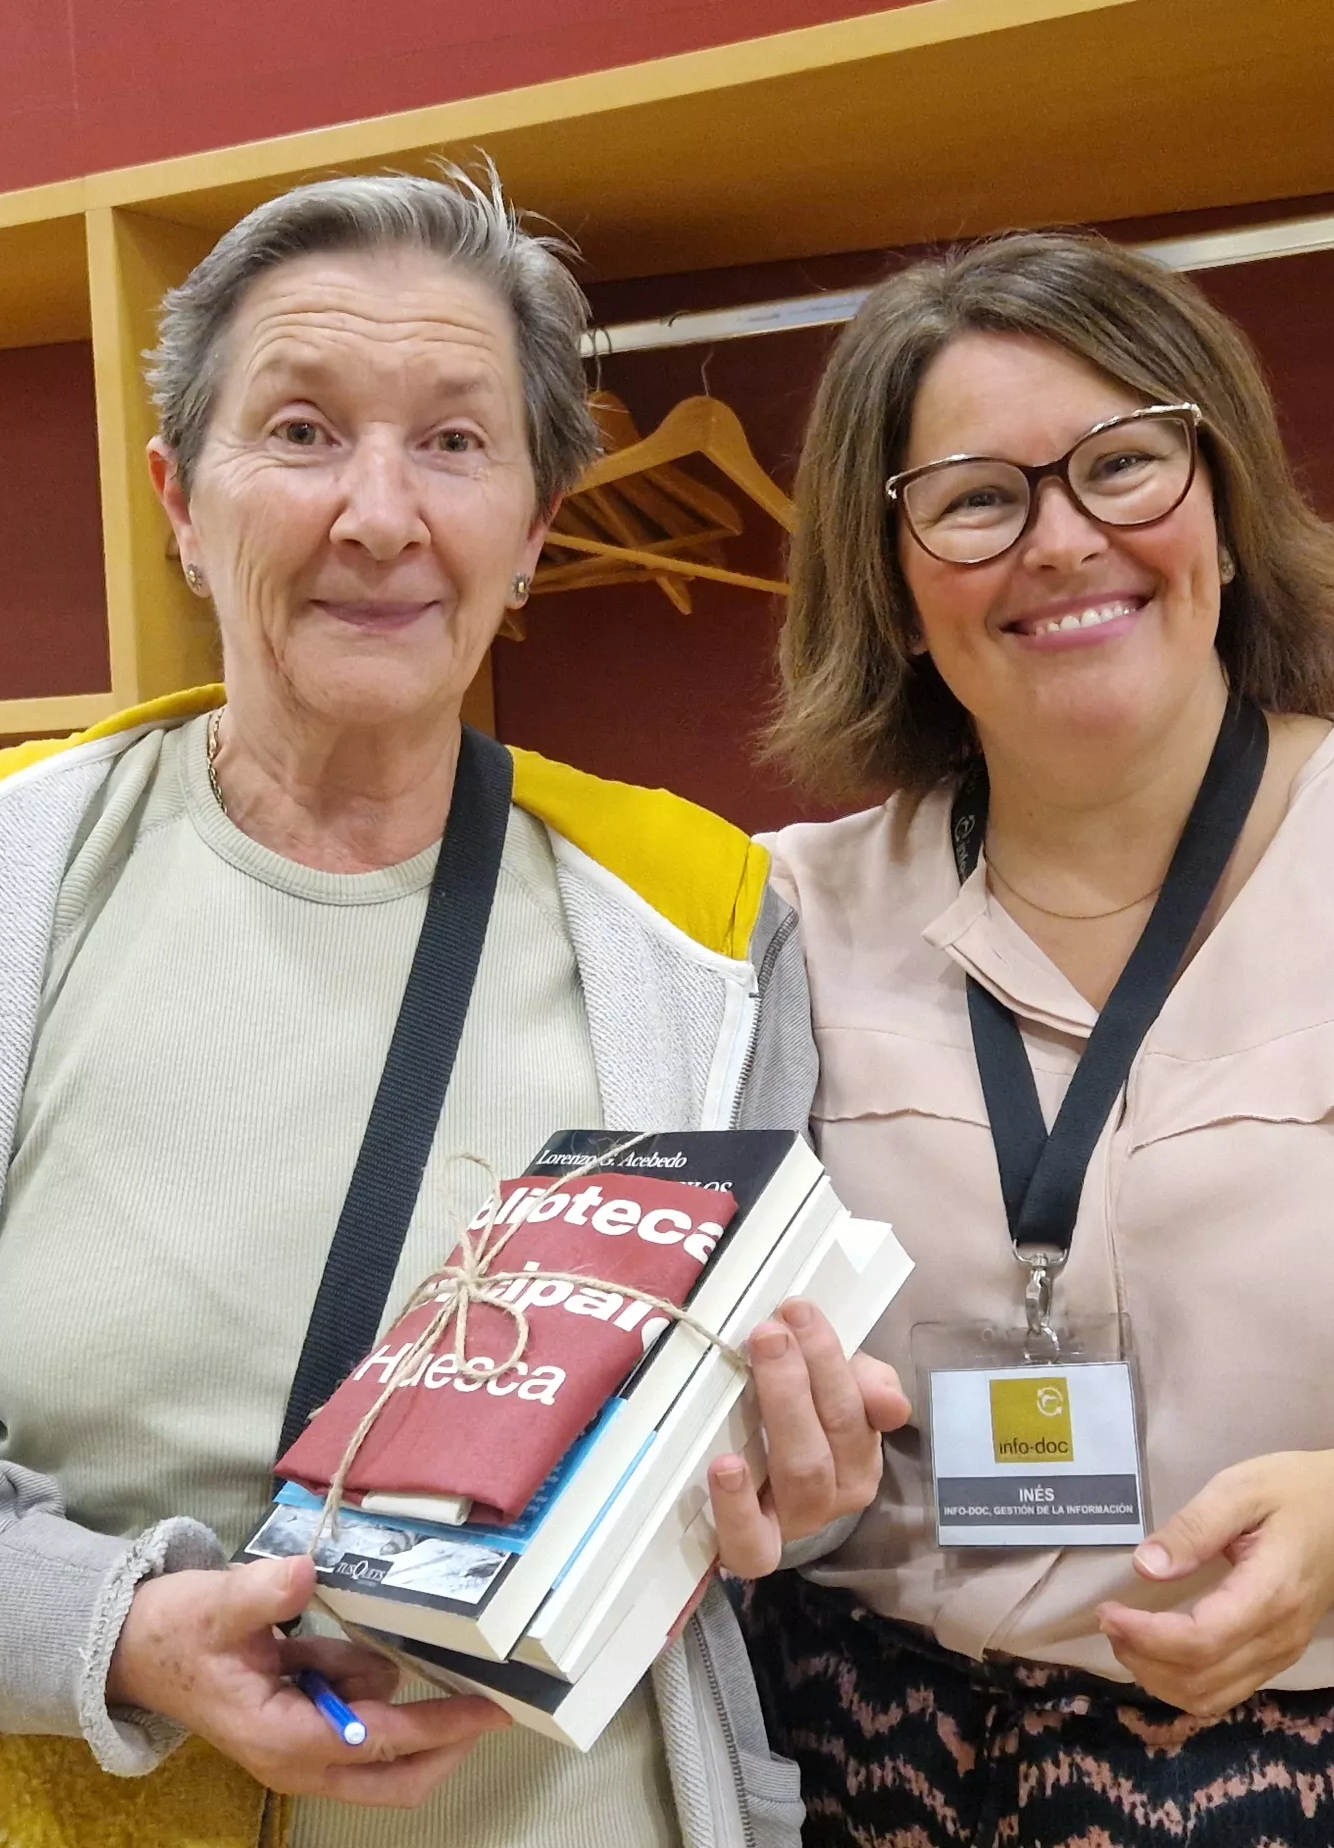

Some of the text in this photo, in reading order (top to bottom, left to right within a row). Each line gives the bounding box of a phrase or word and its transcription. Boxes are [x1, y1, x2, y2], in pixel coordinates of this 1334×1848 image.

[536, 1149, 598, 1166] Lorenzo
[617, 1151, 688, 1169] Acebedo
[353, 1342, 567, 1406] Huesca
[999, 1437, 1070, 1456] info-doc
[1018, 1484, 1055, 1503] INÉS
[943, 1503, 1134, 1517] INFO-DOC, GESTIÓN DE LA INFORMACIÓN
